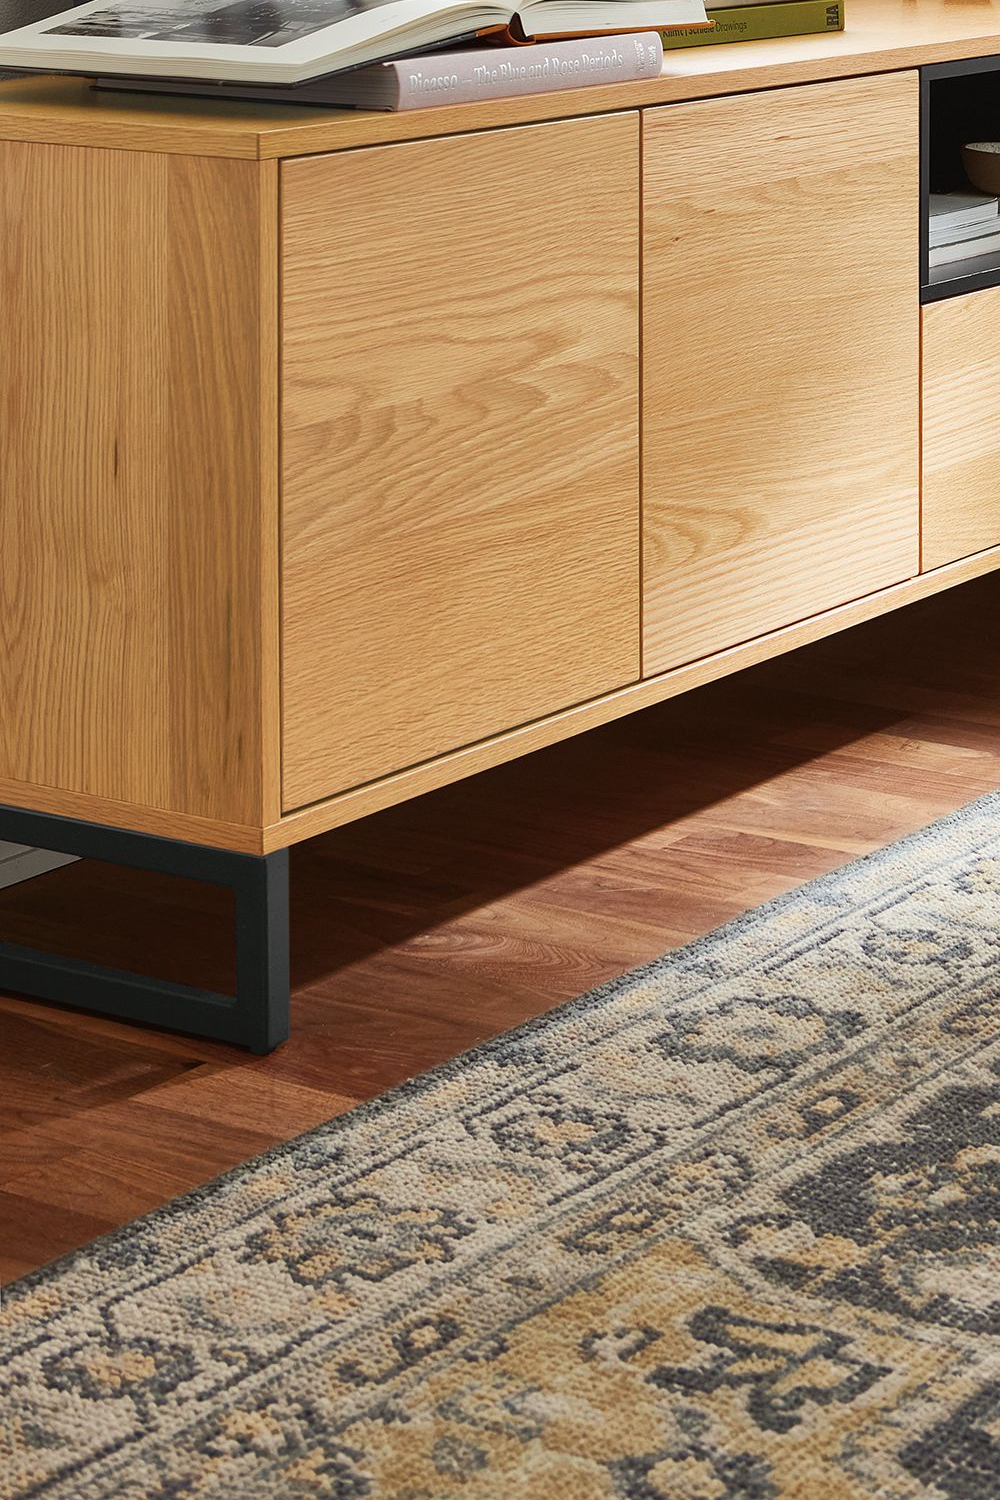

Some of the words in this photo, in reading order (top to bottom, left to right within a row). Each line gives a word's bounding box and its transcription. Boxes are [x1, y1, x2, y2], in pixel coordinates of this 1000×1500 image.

[716, 21, 748, 33] Drawings
[409, 72, 458, 95] Picasso
[473, 65, 498, 86] The
[500, 61, 526, 82] Blue
[528, 58, 549, 79] and
[551, 57, 580, 76] Rose
[582, 49, 624, 71] Periods
